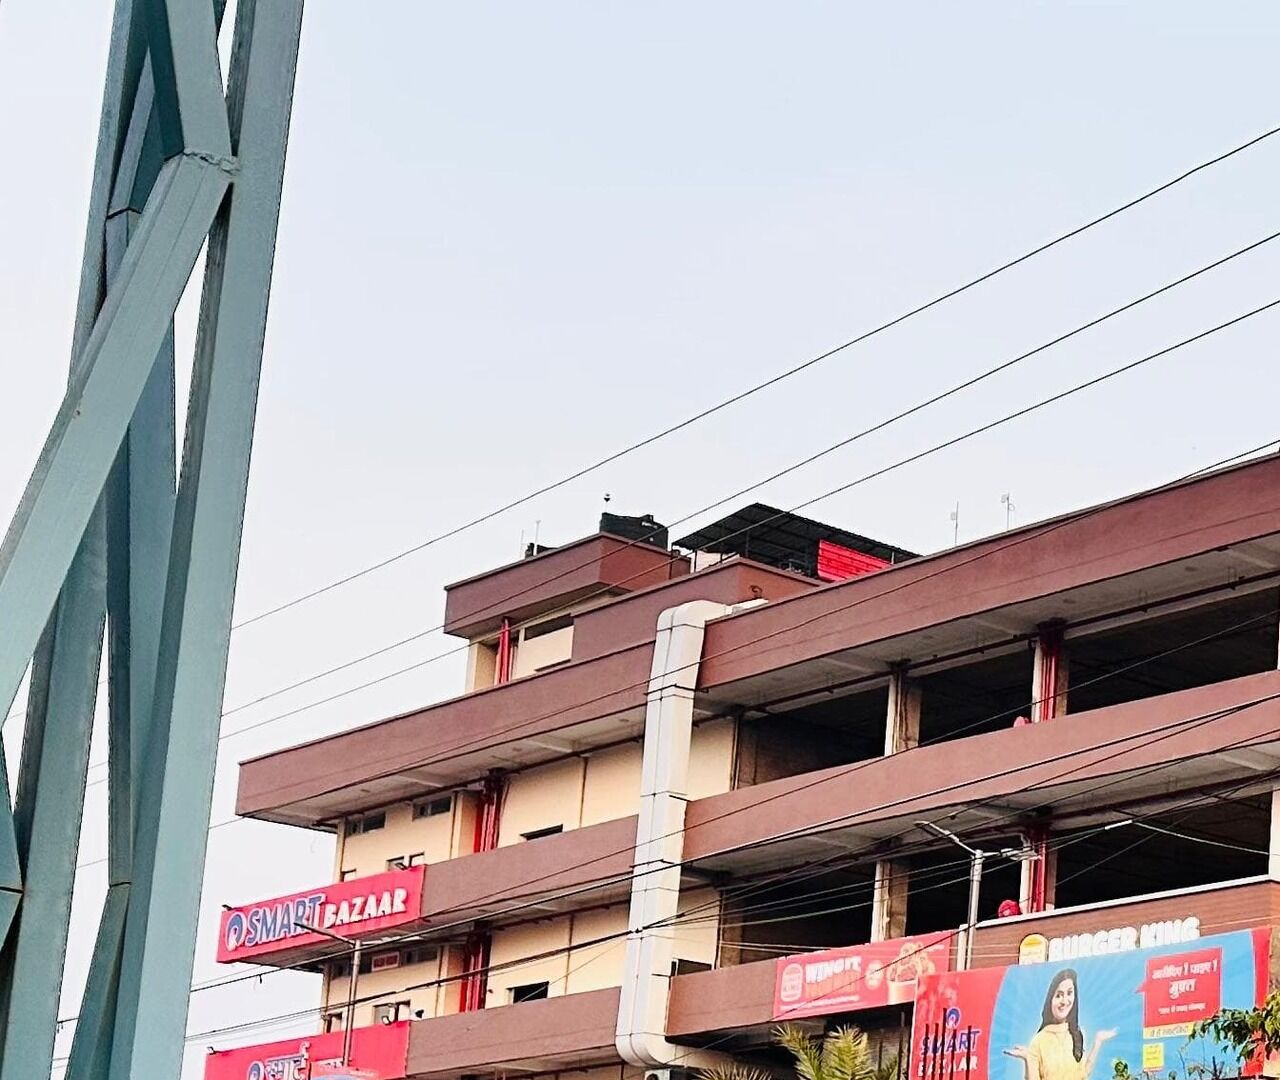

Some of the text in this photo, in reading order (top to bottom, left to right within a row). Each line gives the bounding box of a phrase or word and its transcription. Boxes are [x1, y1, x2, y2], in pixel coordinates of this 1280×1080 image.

[245, 888, 409, 947] SMART BAZAAR
[1048, 916, 1201, 962] BURGER KING
